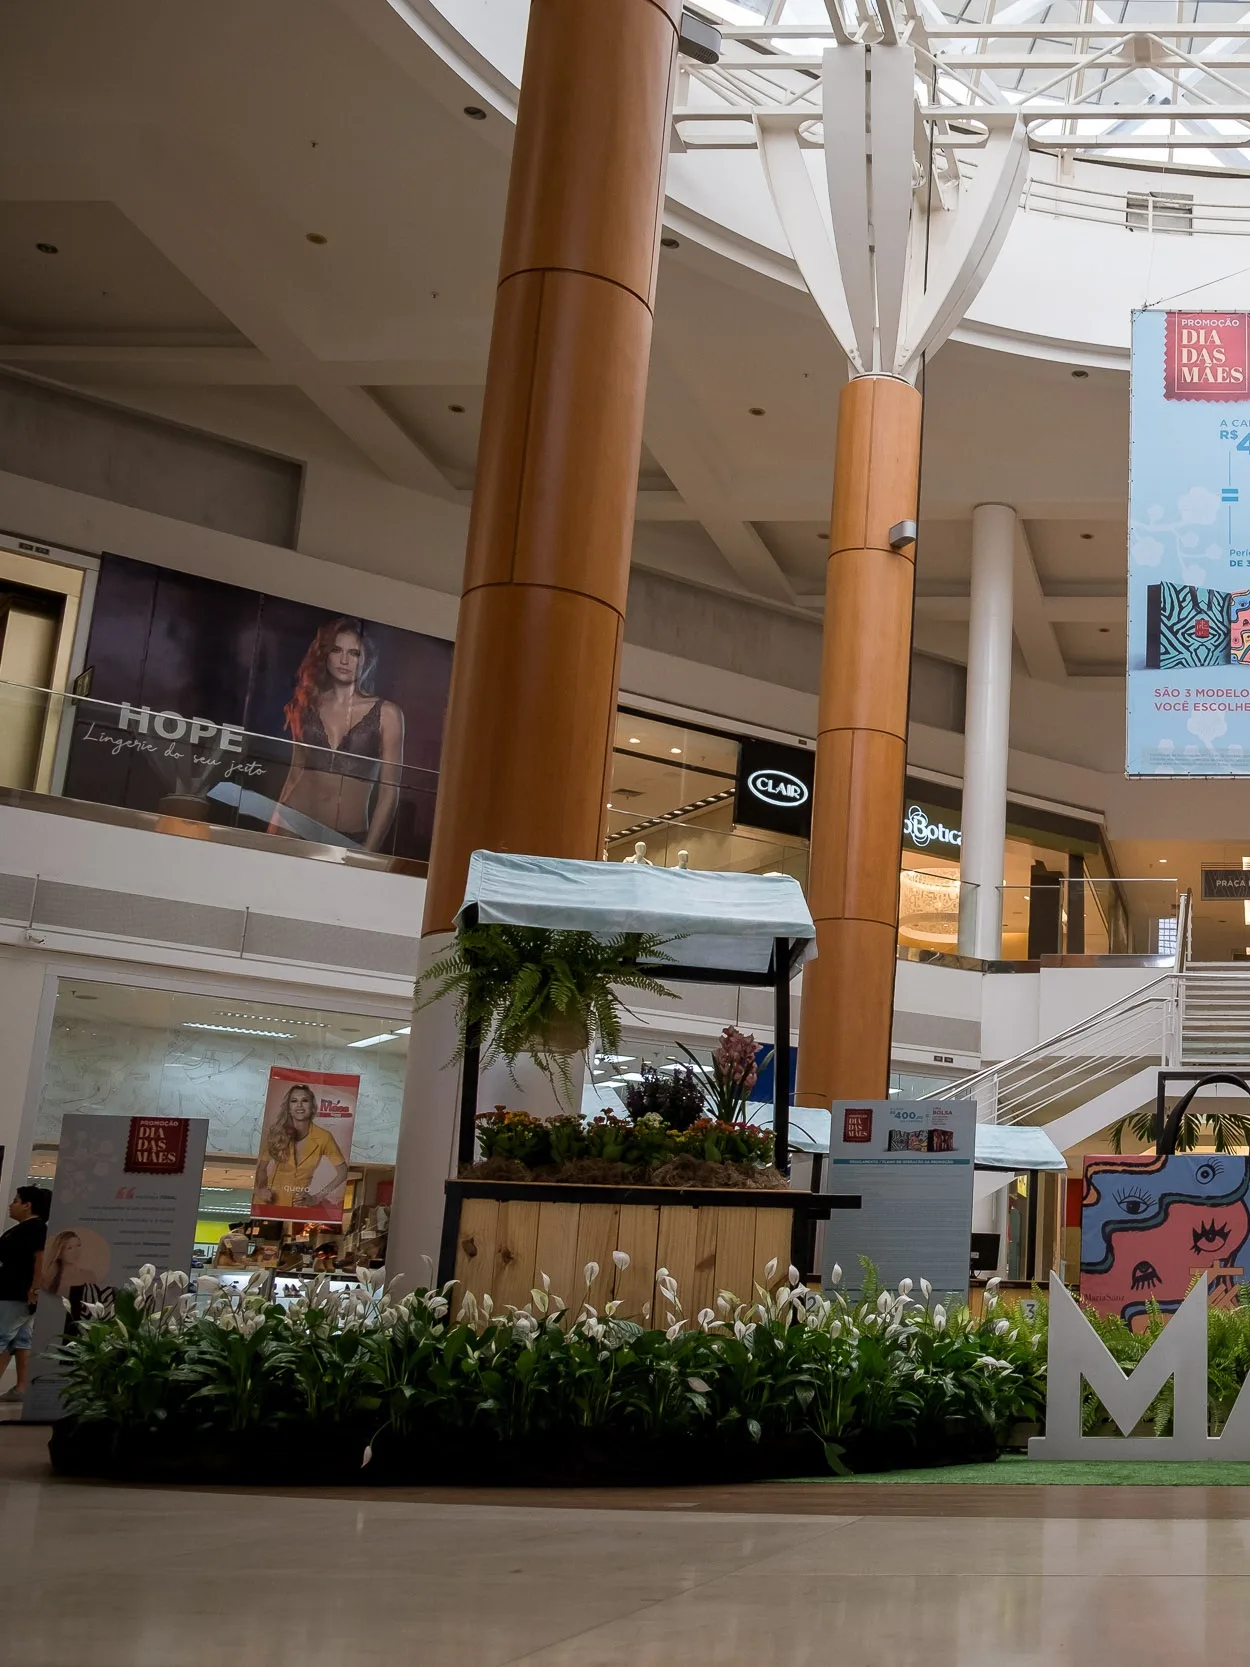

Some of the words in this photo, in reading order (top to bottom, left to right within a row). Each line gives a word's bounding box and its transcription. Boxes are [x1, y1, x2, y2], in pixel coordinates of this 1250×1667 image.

[1181, 317, 1240, 328] PROMOÇÃO
[1181, 329, 1222, 345] DIA
[1181, 348, 1226, 364] DAS
[1180, 364, 1244, 383] MÃES
[1220, 419, 1229, 428] A
[1229, 559, 1243, 568] DE
[1154, 686, 1181, 698] SÃO
[1184, 689, 1191, 698] 3
[1154, 700, 1189, 712] VOCÊ
[118, 701, 245, 753] HOPE
[83, 722, 158, 755] Lingerie
[164, 743, 184, 759] do
[193, 754, 222, 765] seu
[224, 760, 267, 778] jeito
[755, 776, 801, 799] CLAIR
[139, 1127, 165, 1138] DIA
[137, 1139, 167, 1150] DAS
[136, 1150, 177, 1163] MÃES
[1026, 1303, 1036, 1320] 3
